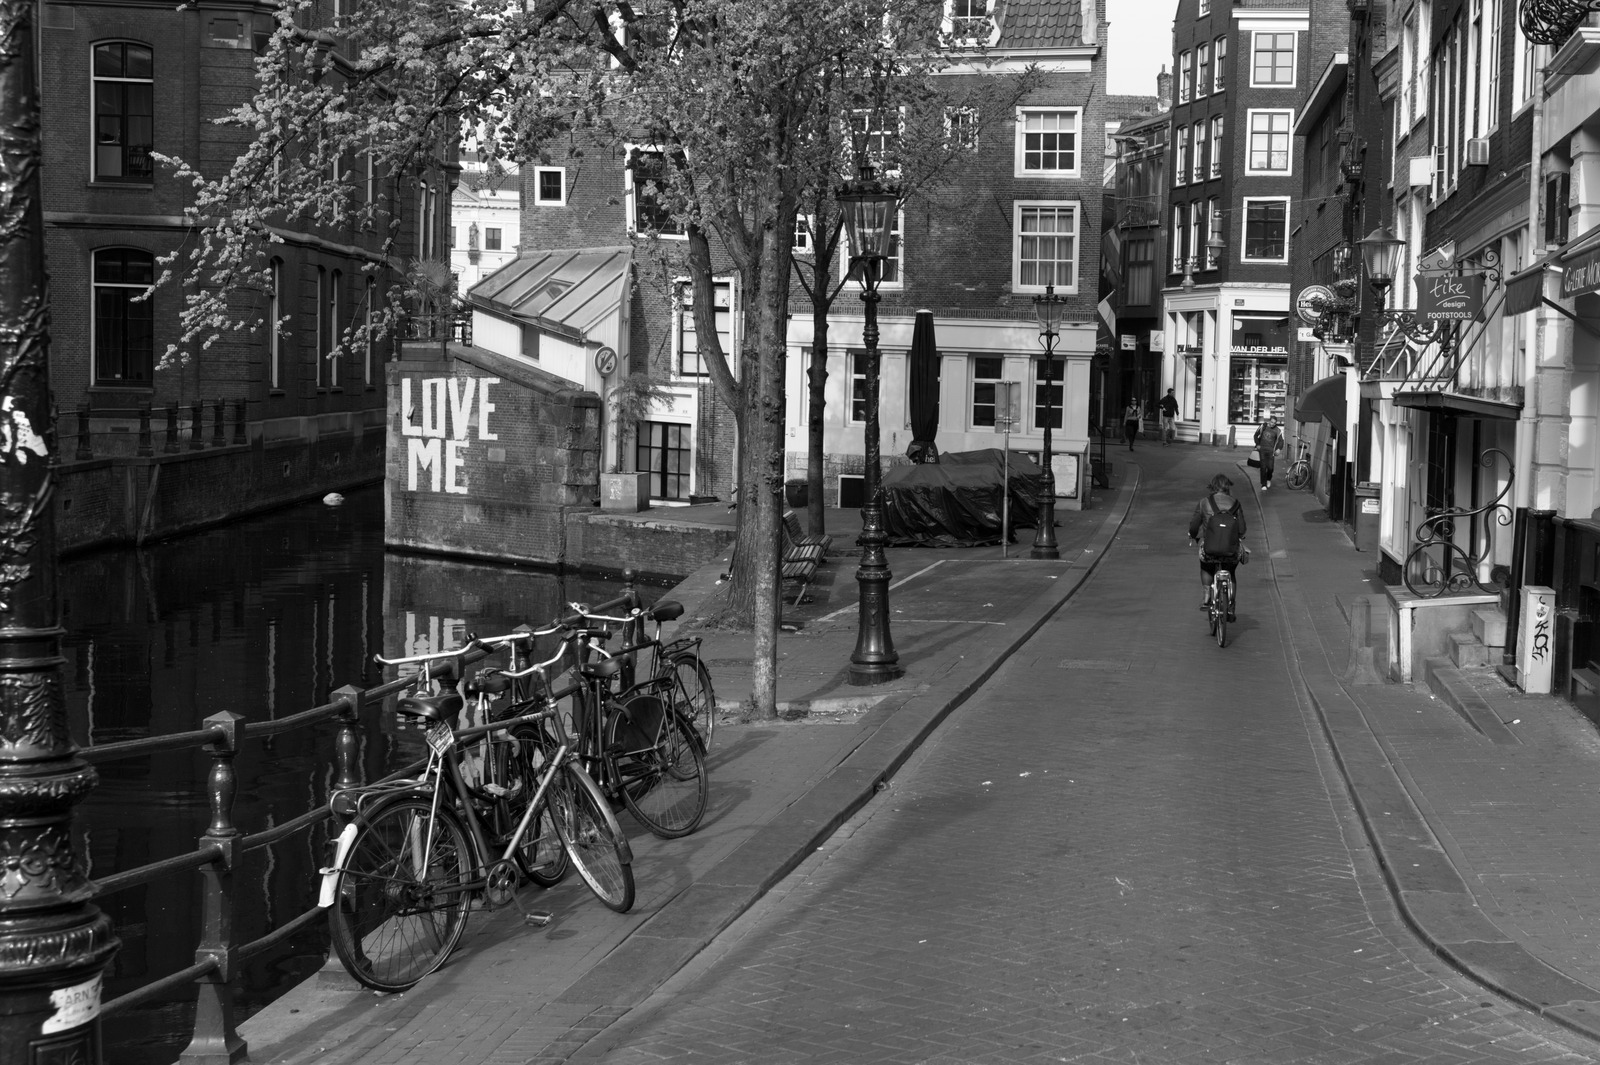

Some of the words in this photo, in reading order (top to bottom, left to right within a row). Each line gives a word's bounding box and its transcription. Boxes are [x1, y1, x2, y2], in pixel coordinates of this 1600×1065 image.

[1430, 276, 1466, 298] tike
[1427, 311, 1472, 319] FOOTSTOOLS
[1442, 301, 1466, 309] design
[402, 377, 500, 440] LOVE
[407, 438, 469, 494] ME
